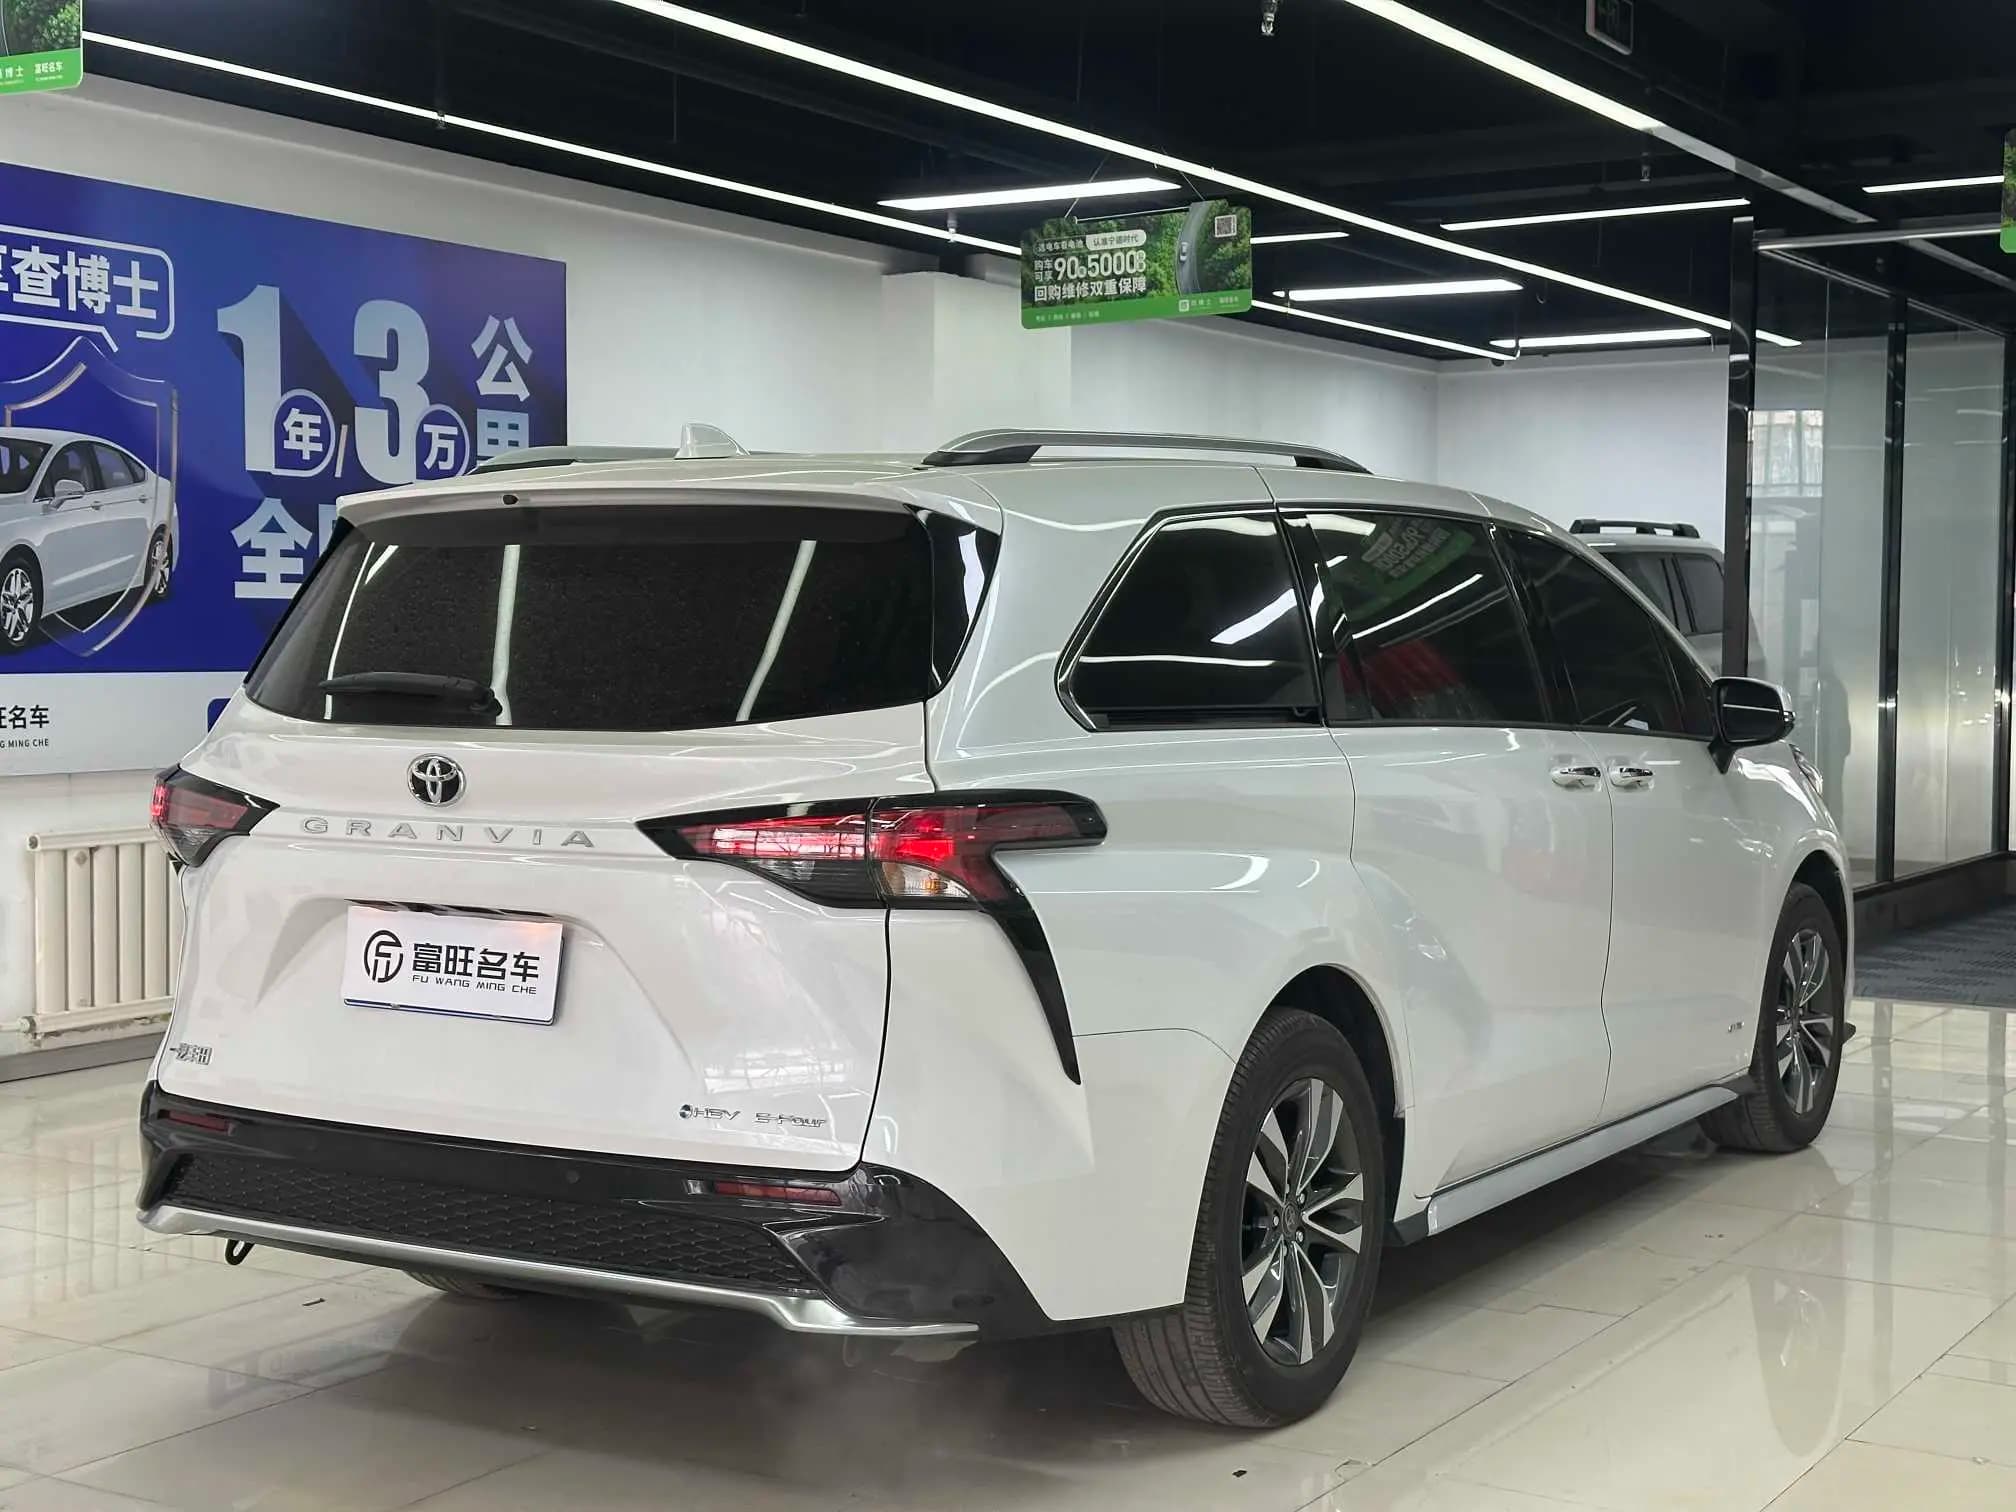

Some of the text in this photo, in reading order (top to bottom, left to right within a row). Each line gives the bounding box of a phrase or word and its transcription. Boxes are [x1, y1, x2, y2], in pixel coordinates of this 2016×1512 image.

[1034, 276, 1147, 302] 回购维修双重保障
[8, 739, 30, 748] MING
[32, 738, 49, 747] CHE
[303, 816, 595, 849] GRANVIA
[412, 942, 540, 983] 富旺名车
[412, 974, 537, 995] FU WANG MING CHE
